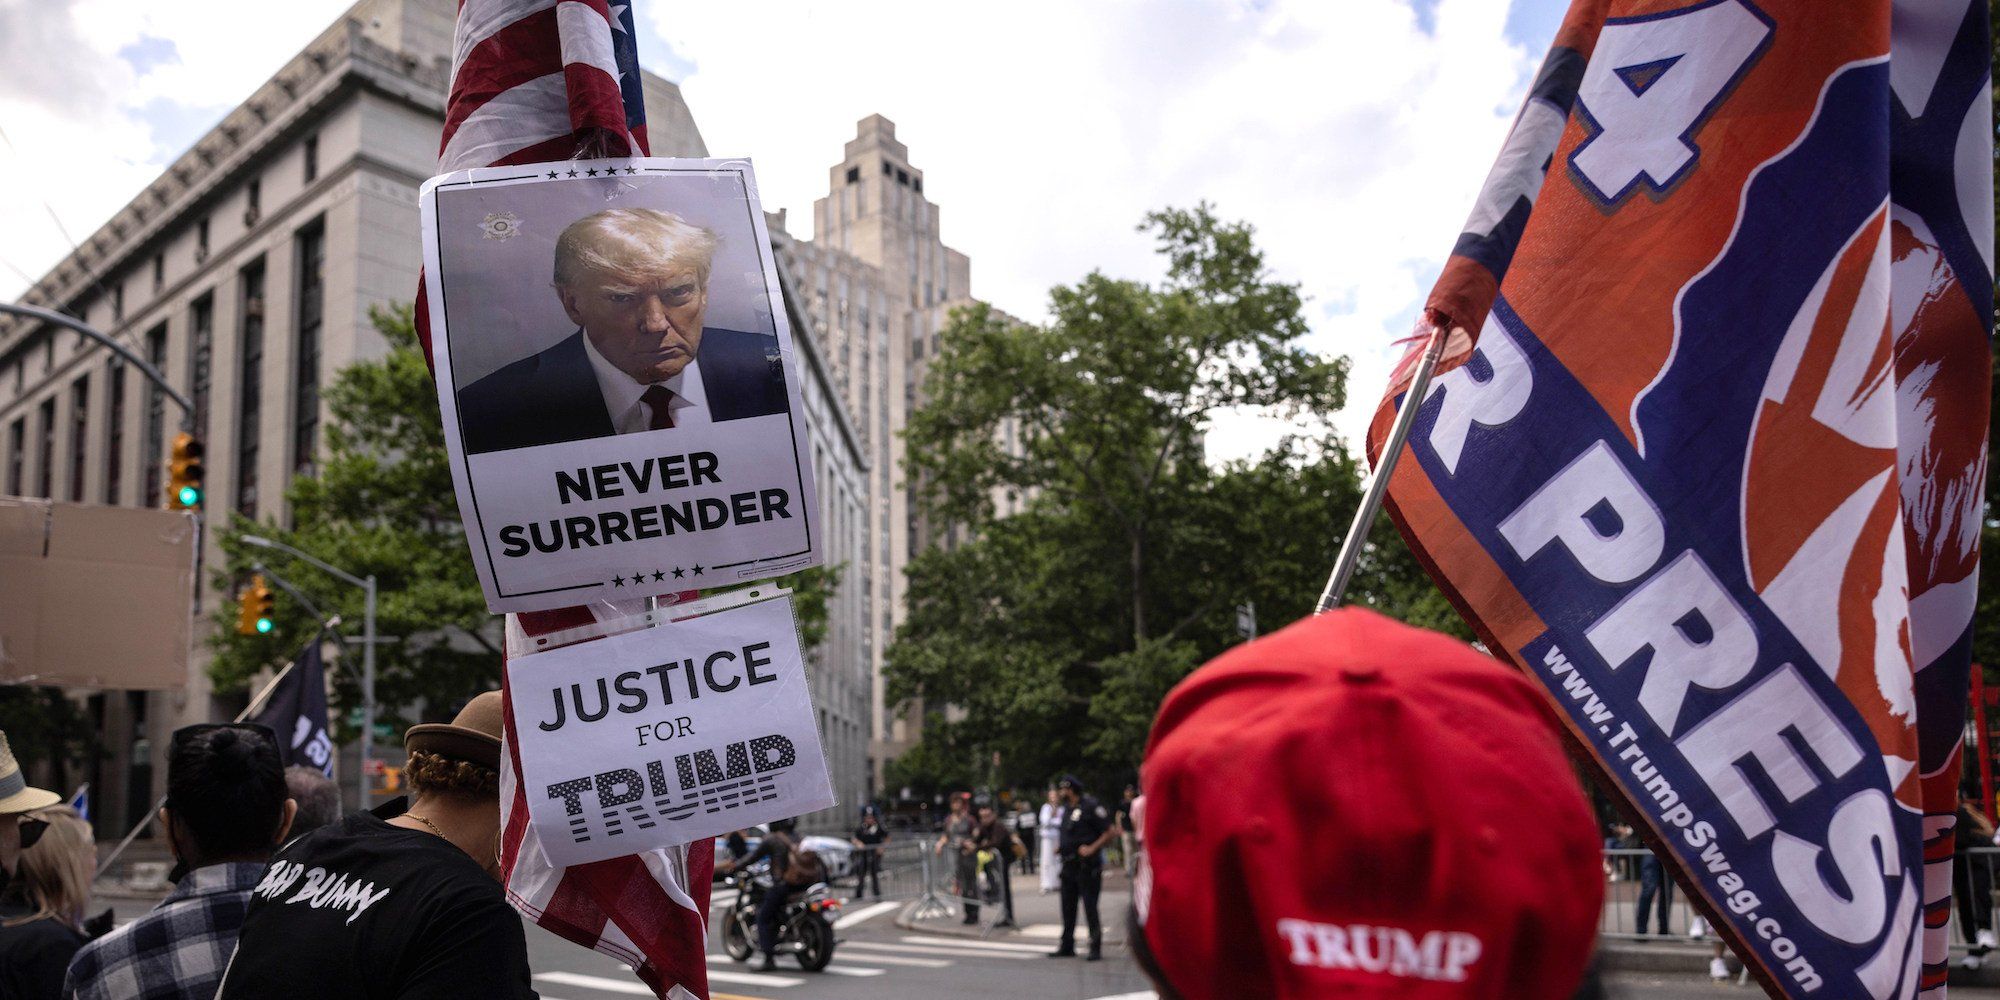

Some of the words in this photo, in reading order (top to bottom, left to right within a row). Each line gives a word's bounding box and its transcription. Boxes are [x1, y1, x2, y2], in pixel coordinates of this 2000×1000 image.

[555, 451, 722, 504] NEVER
[499, 488, 792, 558] SURRENDER
[538, 641, 778, 732] JUSTICE
[1496, 439, 1923, 1000] PRESI
[635, 716, 695, 747] FOR
[547, 734, 796, 843] TRUMP
[1542, 644, 1824, 993] www.TrumpSwag.com
[254, 860, 304, 901] BAD
[285, 867, 390, 926] BUNNY
[1276, 917, 1482, 983] TRUMP
